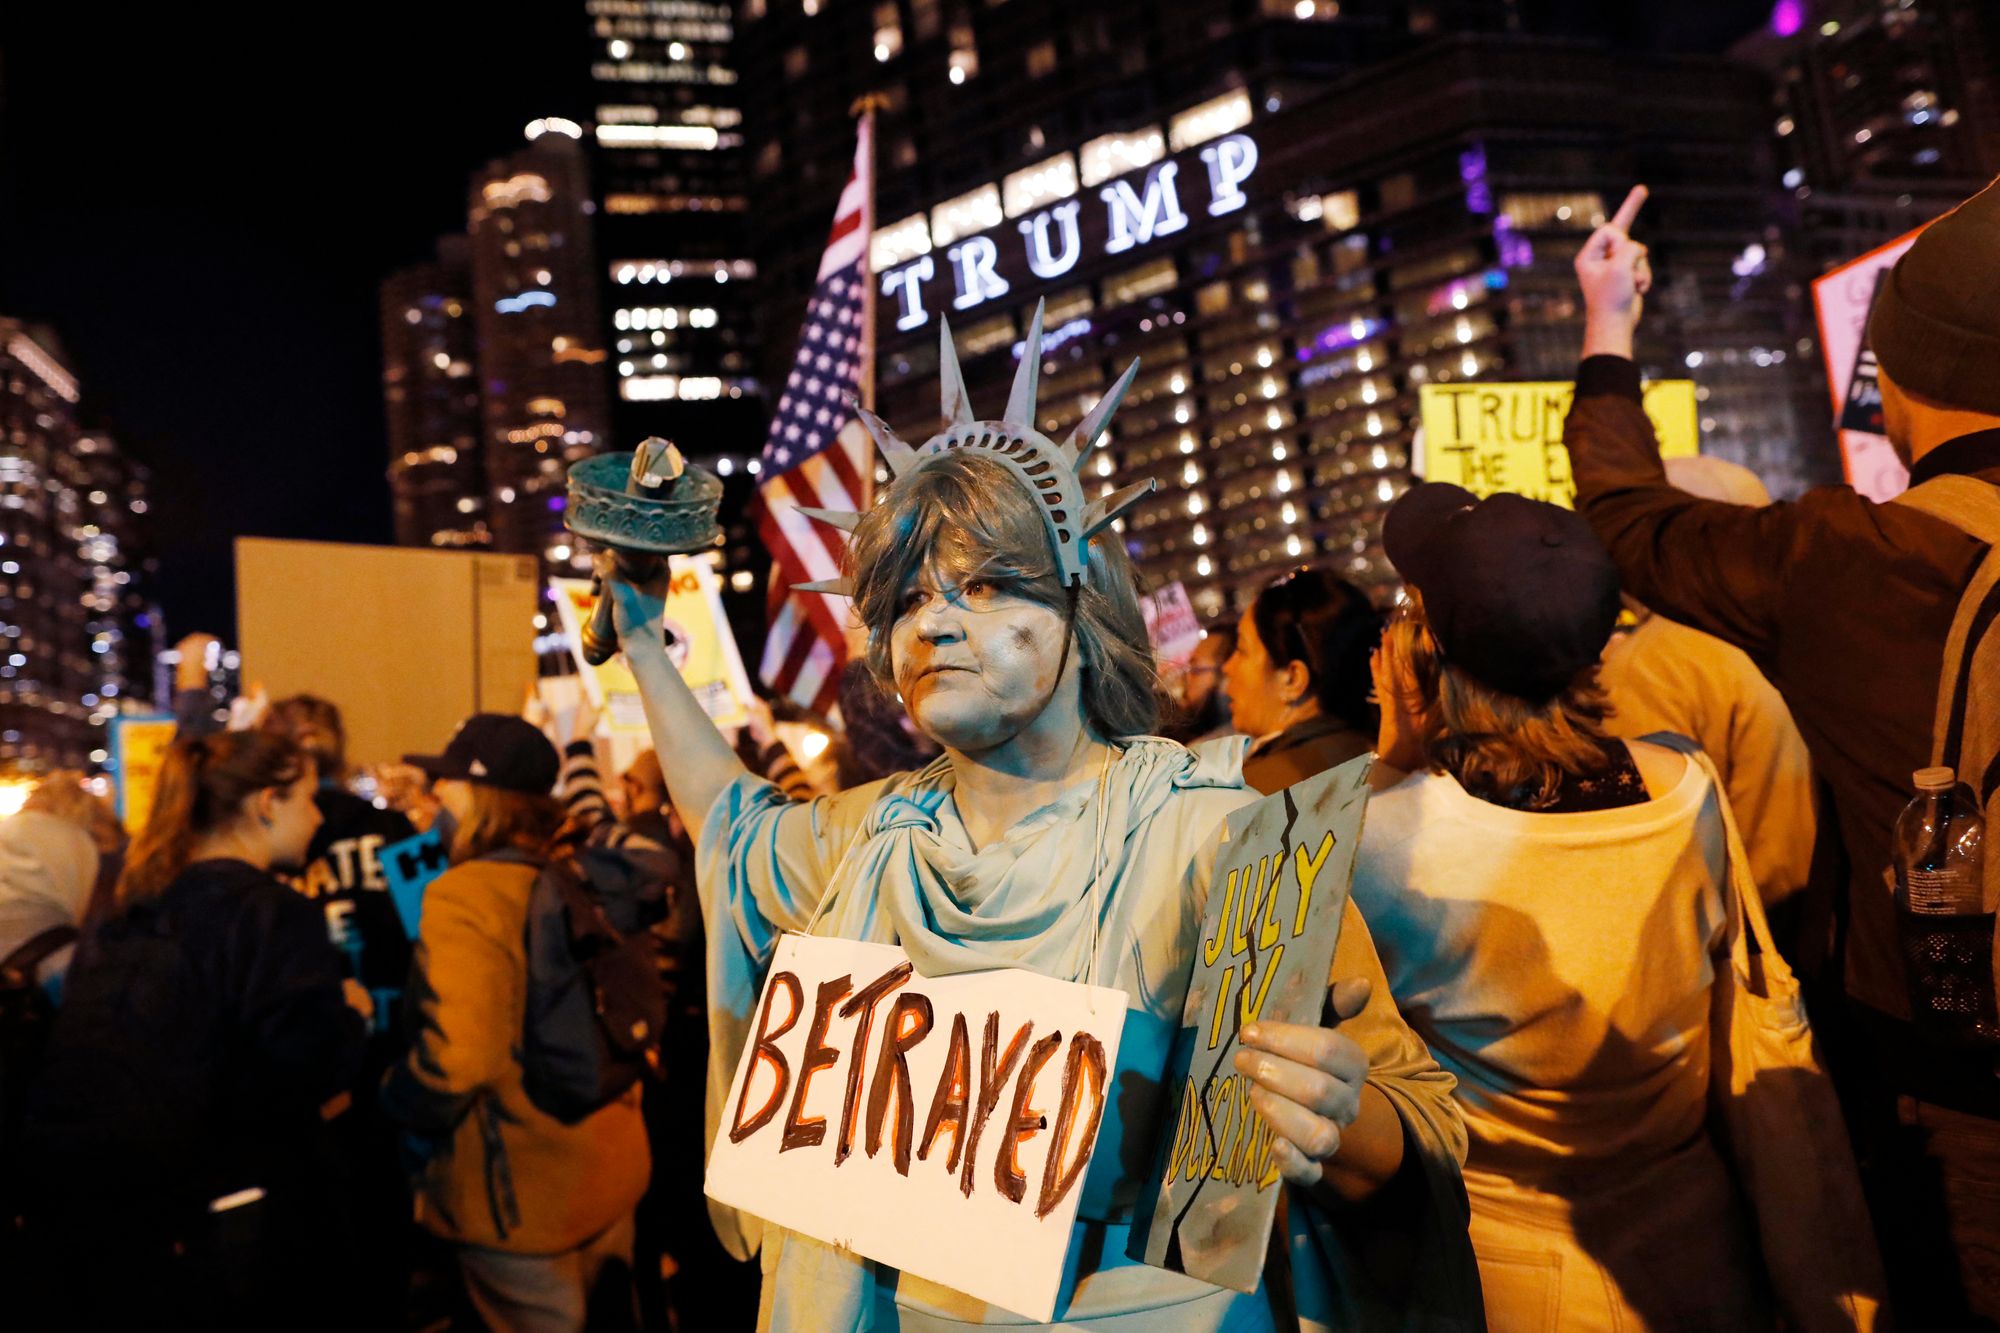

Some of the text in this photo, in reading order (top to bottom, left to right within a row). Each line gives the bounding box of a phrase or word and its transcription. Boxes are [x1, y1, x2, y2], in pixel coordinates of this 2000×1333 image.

[881, 133, 1258, 332] TRUMP
[1434, 390, 1575, 441] TRUM
[1441, 445, 1506, 485] THE
[1204, 830, 1336, 967] JULY
[1207, 944, 1285, 1050] IV
[729, 961, 1107, 1221] BETRAYED
